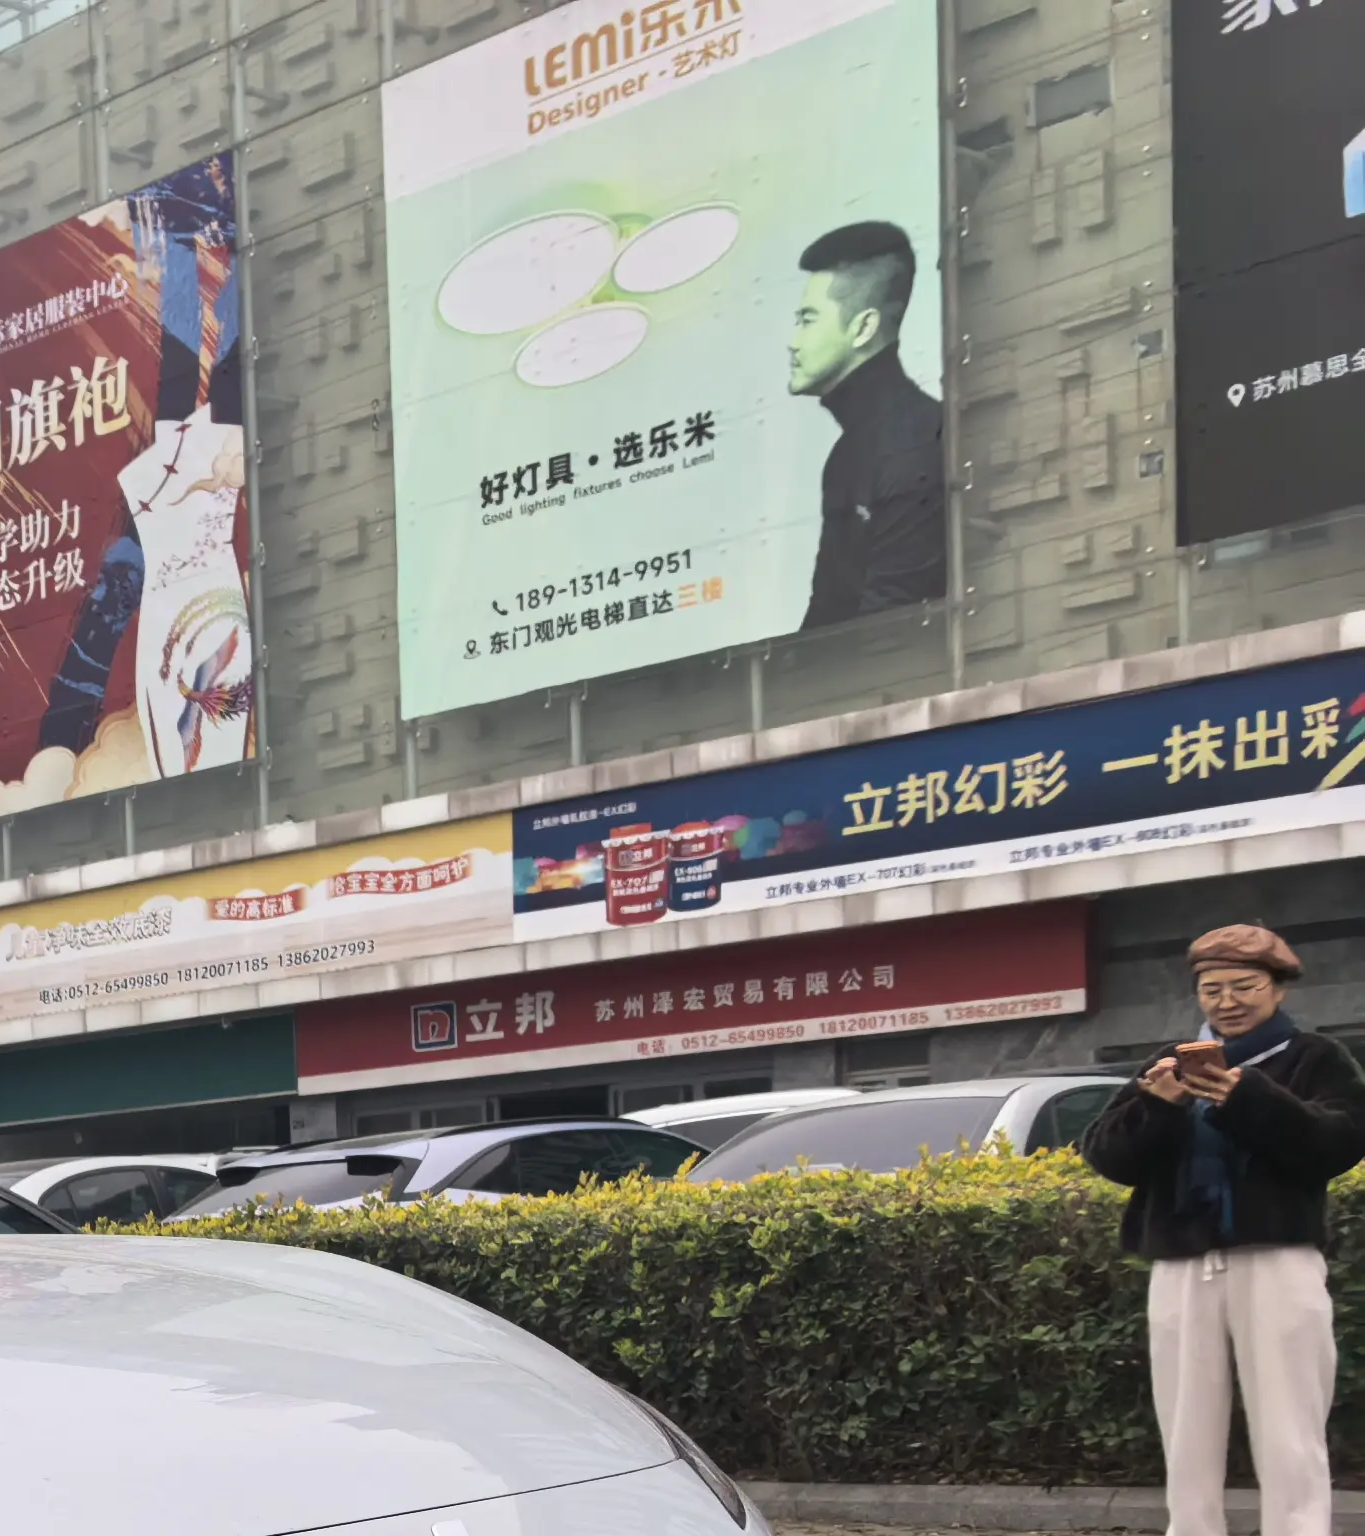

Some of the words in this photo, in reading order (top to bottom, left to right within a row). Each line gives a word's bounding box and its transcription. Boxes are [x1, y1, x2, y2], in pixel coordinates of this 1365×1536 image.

[527, 71, 650, 135] Designer
[672, 29, 743, 79] 艺术灯
[482, 507, 514, 526] Good
[520, 493, 566, 517] lighting
[572, 477, 623, 500] fixtures
[629, 463, 675, 484] choose
[516, 549, 692, 612] 189-1314-9951
[842, 750, 1070, 836] 立邦幻彩
[177, 957, 269, 983] 18120071185
[277, 939, 376, 968] 13862027993
[465, 990, 556, 1043] 立邦
[594, 964, 896, 1023] 苏州泽宏贸易有限公司
[681, 1025, 806, 1050] 0512-65499850
[819, 1011, 930, 1035] 18120071185
[943, 995, 1064, 1022] 13862027993
